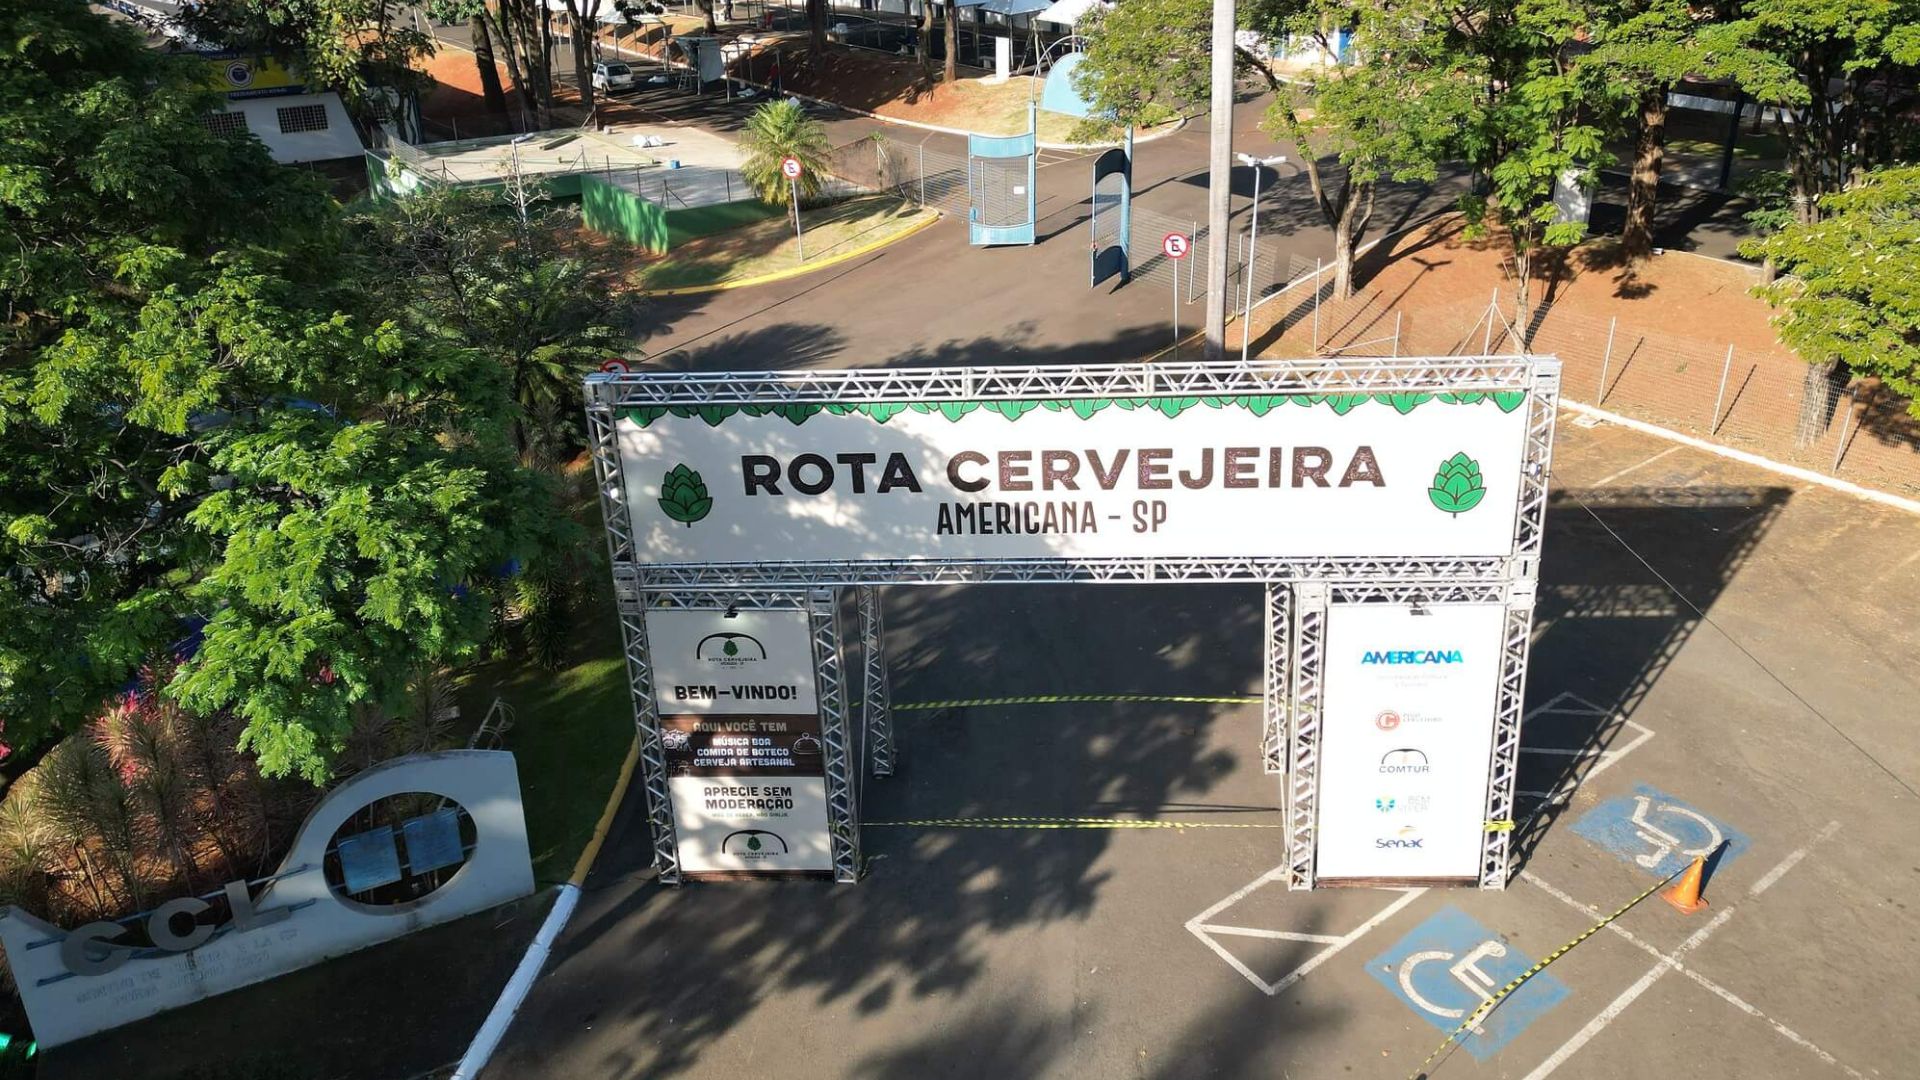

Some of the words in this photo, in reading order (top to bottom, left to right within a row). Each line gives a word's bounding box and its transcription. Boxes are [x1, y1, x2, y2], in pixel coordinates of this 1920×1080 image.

[741, 452, 923, 496] ROTA
[946, 446, 1386, 493] CERVEJEIRA
[937, 501, 1098, 534] AMERICANA
[1132, 500, 1167, 534] SP
[1361, 650, 1464, 664] AMERICANA
[674, 685, 797, 700] BEM-VINDO!
[693, 722, 721, 732] AQUI
[725, 718, 757, 732] VOCÊ
[760, 722, 787, 732] TEM
[712, 735, 750, 746] MÚSICA
[752, 738, 772, 746] BOA
[697, 748, 733, 757] COMIDA
[736, 748, 750, 757] DE
[752, 748, 789, 757] BOTECO
[693, 758, 737, 767] CERVEJA
[739, 758, 796, 767] ARTESANAL
[1379, 765, 1429, 773] COMTUR
[704, 786, 759, 796] APRECIE
[763, 786, 792, 796] SEM
[705, 796, 793, 811] MODERAÇÃO
